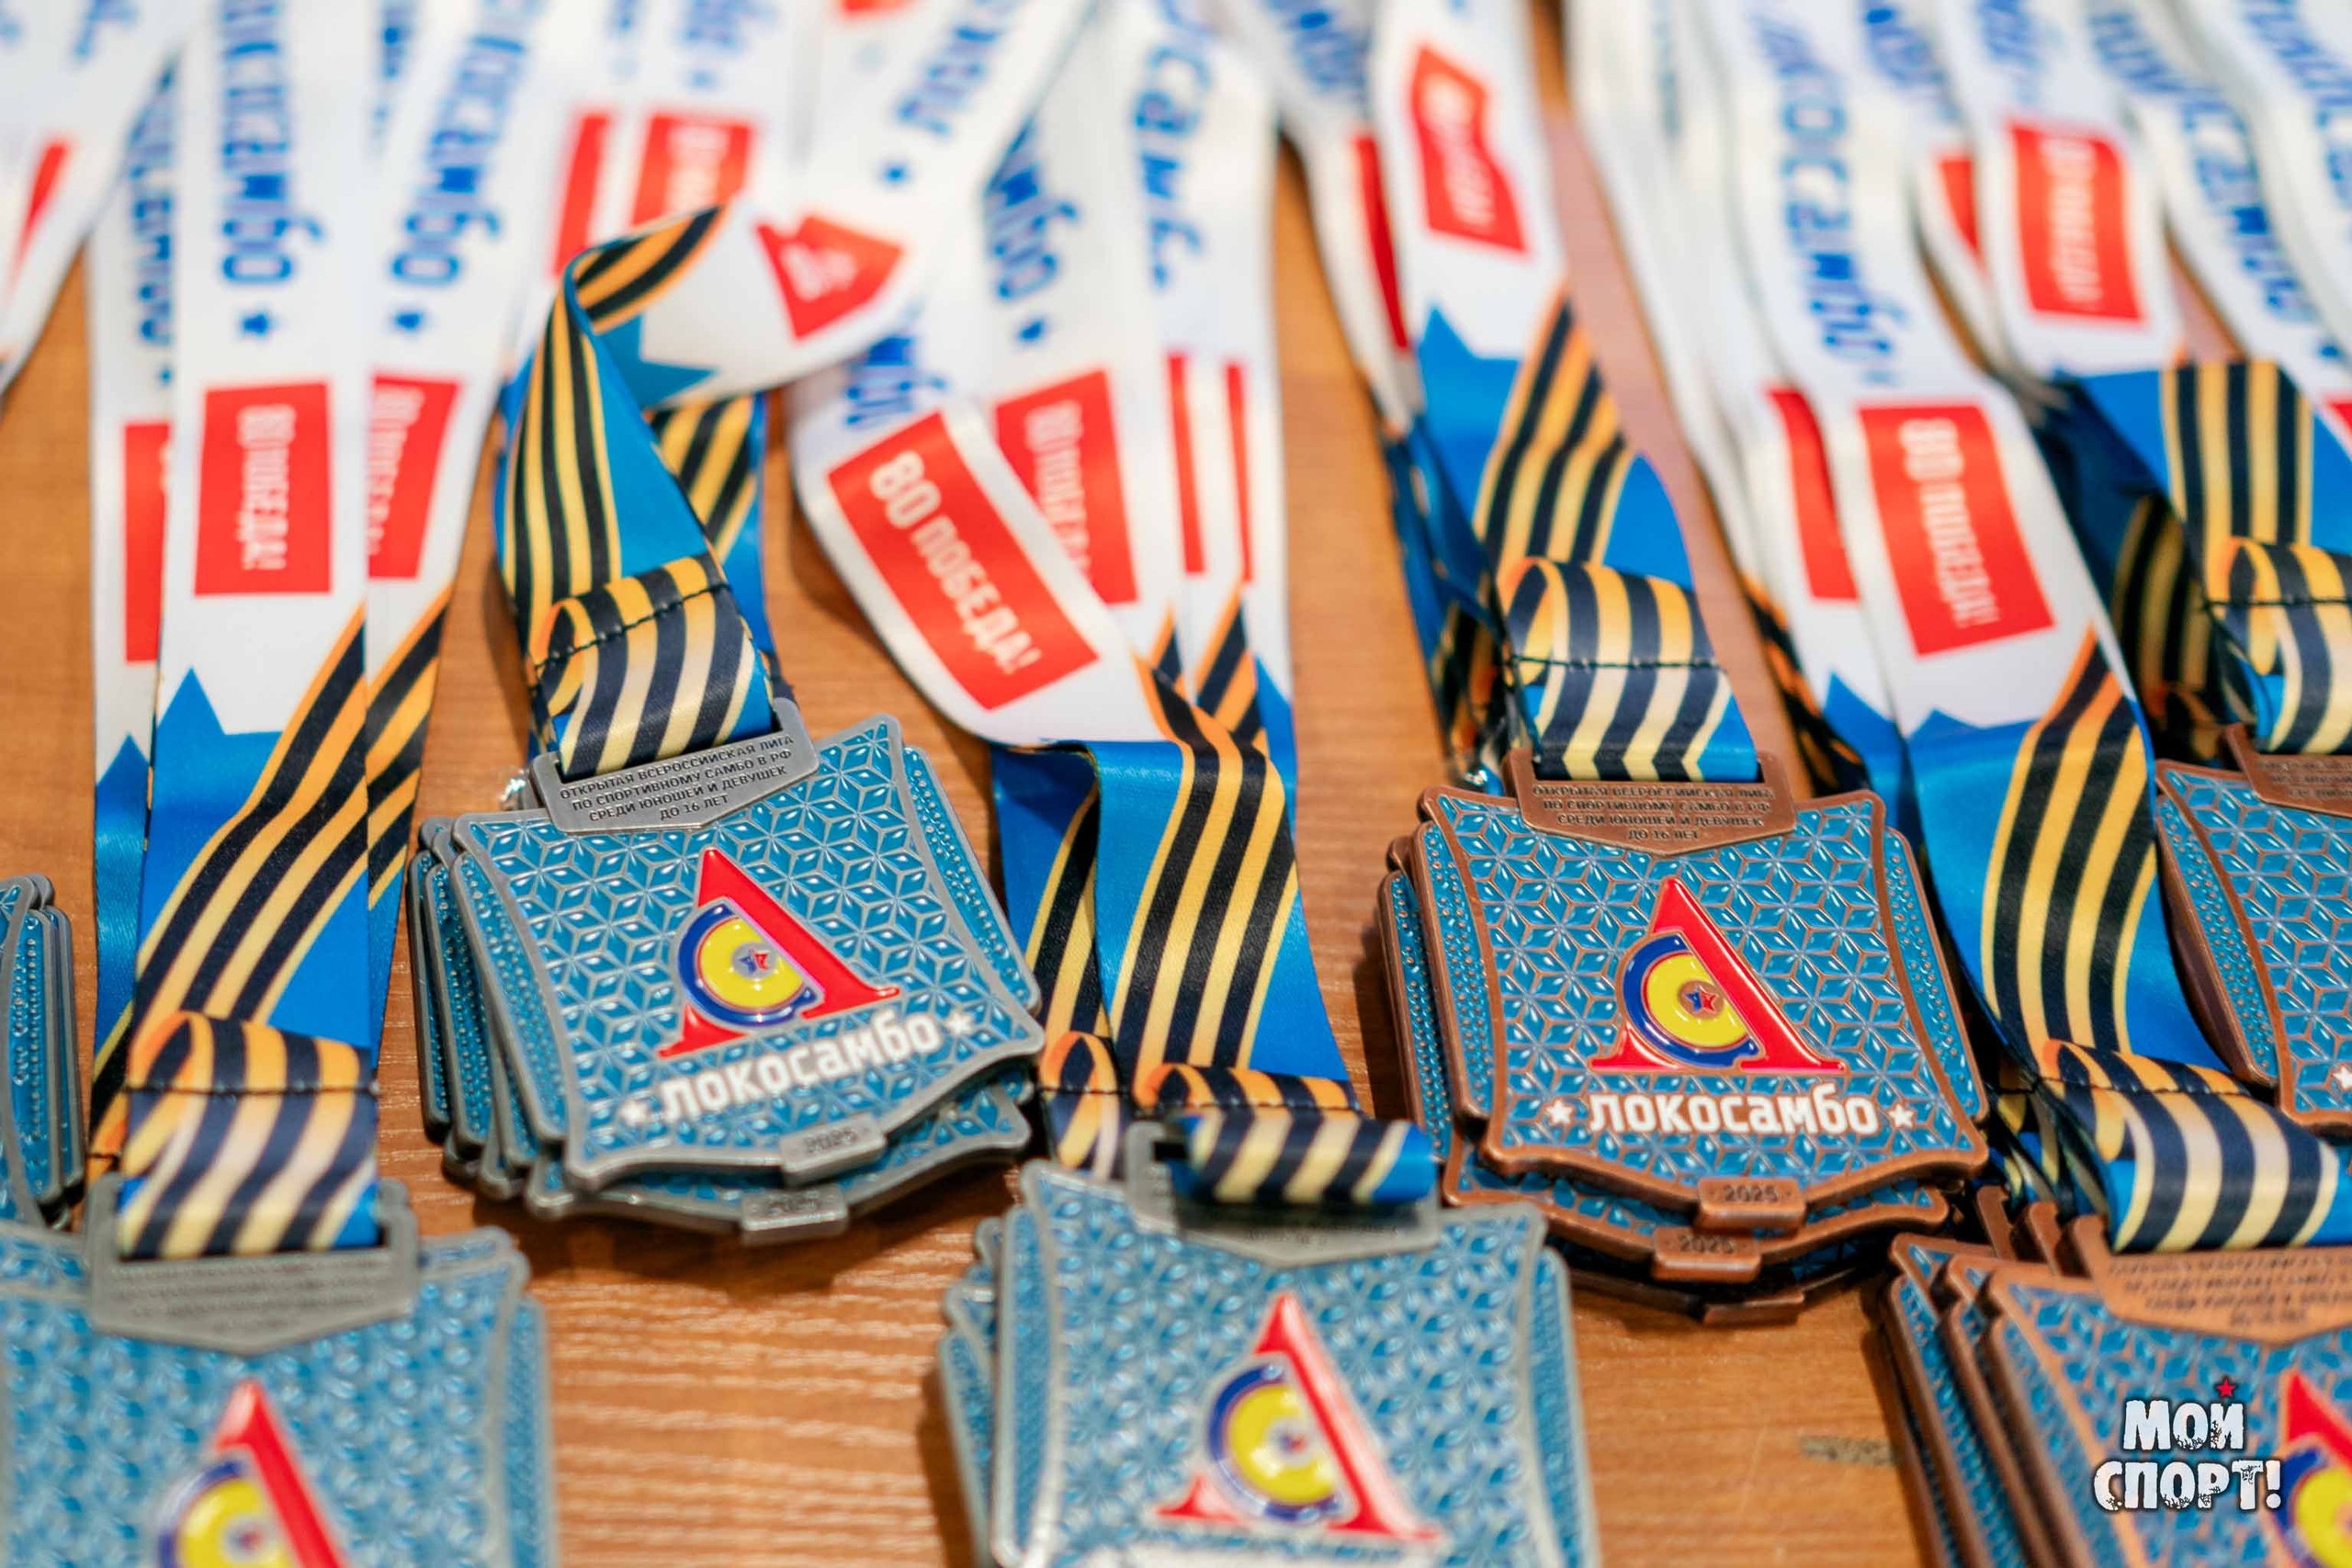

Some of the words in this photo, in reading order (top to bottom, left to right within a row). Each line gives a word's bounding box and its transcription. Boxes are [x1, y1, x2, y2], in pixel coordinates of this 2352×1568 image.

[869, 449, 942, 529] 80
[910, 514, 1042, 675] ПОБЕДА!
[560, 774, 635, 800] ОТКРЫТАЯ
[638, 744, 756, 784] ВСЕРОССИЙСКАЯ
[760, 734, 795, 752] ЛИГА
[572, 796, 593, 812] ПО
[595, 771, 707, 807] СПОРТИВНОМУ
[705, 760, 755, 780] САМБО
[757, 755, 767, 767] В
[771, 749, 793, 765] РФ
[588, 802, 637, 824] СРЕДИ
[640, 784, 705, 810] ЮНОШЕЙ
[707, 782, 718, 794] И
[721, 765, 787, 793] ДЕВУШЕК
[660, 807, 680, 822] ДО
[684, 801, 701, 815] 16
[703, 795, 729, 810] ЛЕТ
[1556, 814, 1605, 827] СРЕДИ
[1724, 1184, 1779, 1202] 2025
